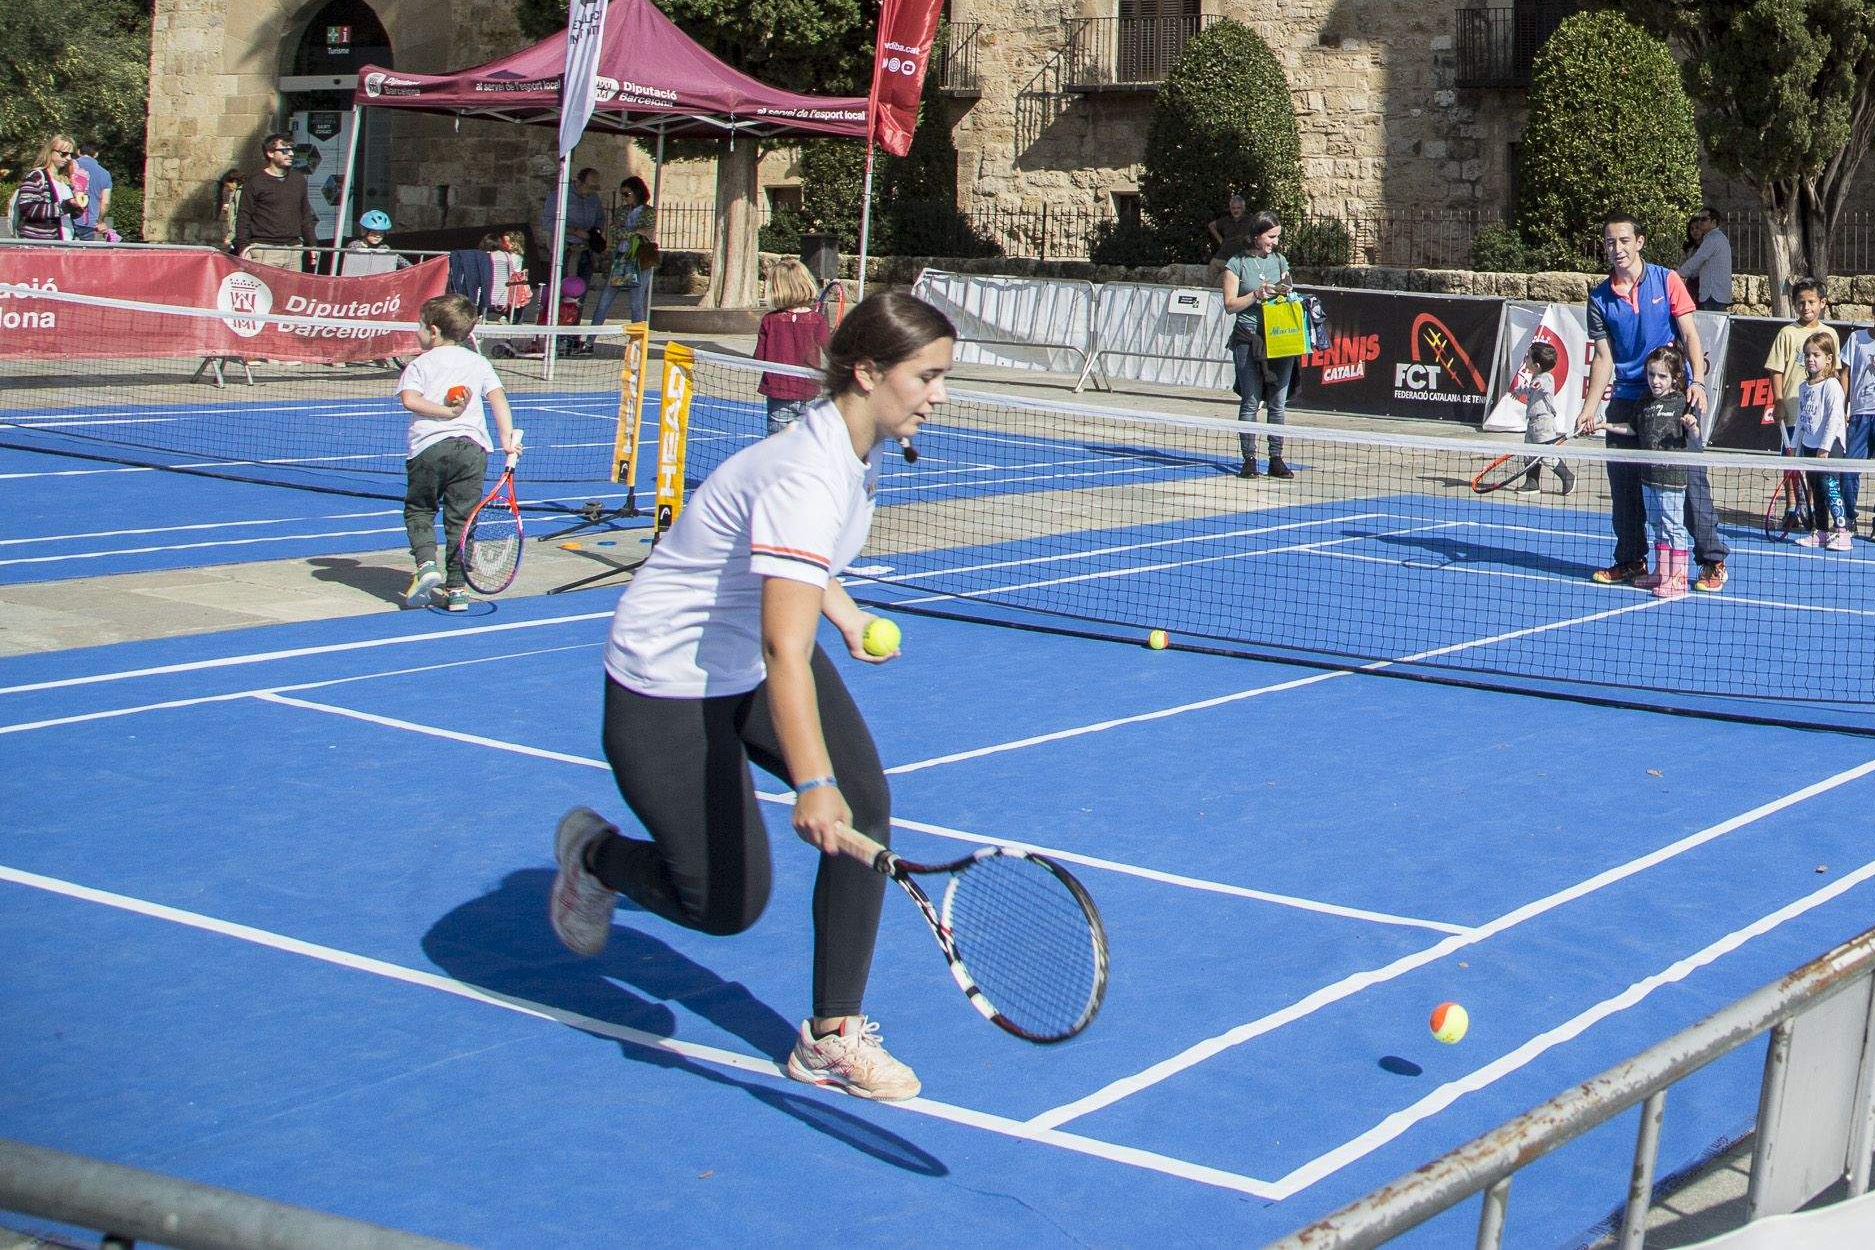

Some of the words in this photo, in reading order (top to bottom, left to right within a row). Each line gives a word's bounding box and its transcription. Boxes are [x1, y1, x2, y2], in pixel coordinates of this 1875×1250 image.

[623, 81, 678, 101] Diputació
[844, 110, 866, 121] local
[284, 293, 402, 318] Diputació
[1323, 359, 1365, 382] CATALÀ
[1394, 362, 1441, 390] FCT
[1394, 389, 1429, 401] FEDERACIÓ
[1429, 392, 1461, 403] CATALANA
[1462, 394, 1471, 403] DE
[659, 364, 687, 497] HEAD
